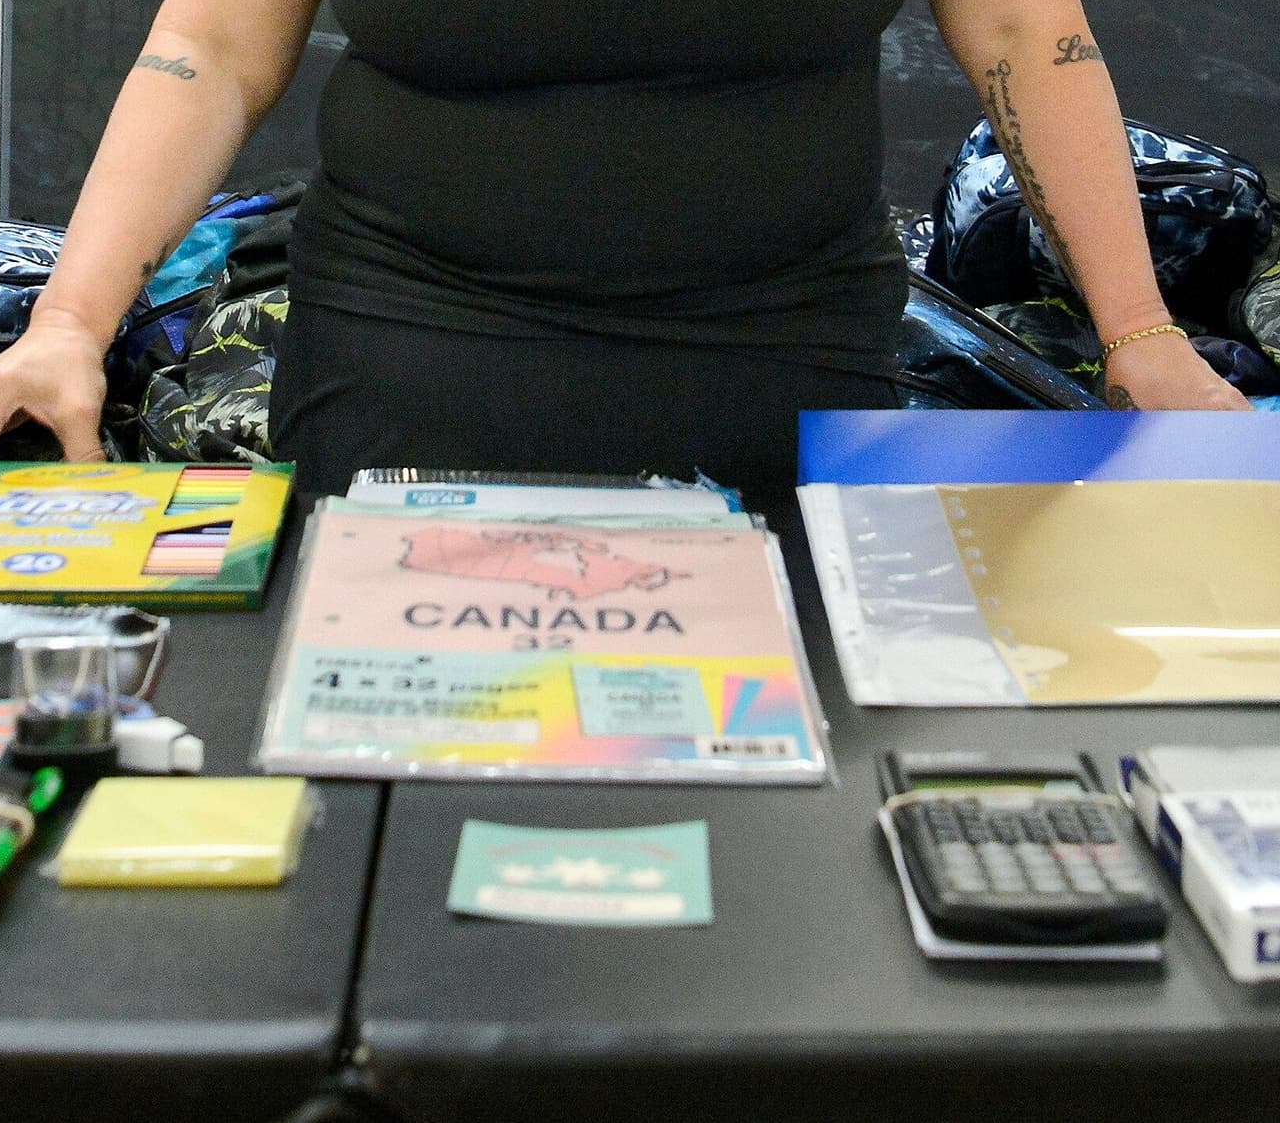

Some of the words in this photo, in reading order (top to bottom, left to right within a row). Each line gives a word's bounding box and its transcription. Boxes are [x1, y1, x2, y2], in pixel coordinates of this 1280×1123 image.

[4, 552, 64, 574] 20
[404, 601, 686, 636] CANADA
[313, 671, 341, 690] 4
[392, 675, 436, 690] 32
